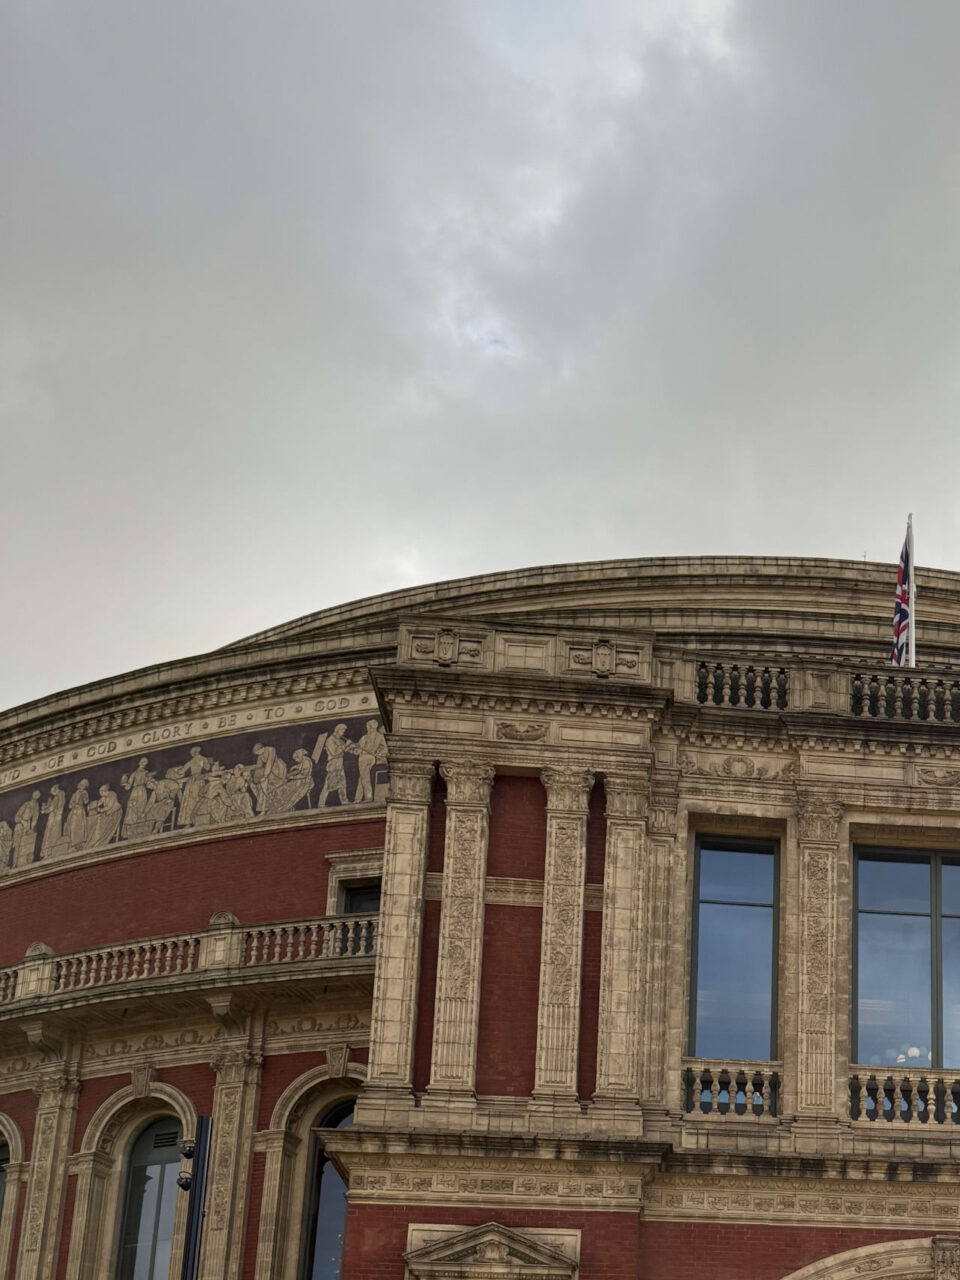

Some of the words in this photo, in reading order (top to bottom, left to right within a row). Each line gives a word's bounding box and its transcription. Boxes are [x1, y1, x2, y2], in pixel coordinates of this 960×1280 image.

[48, 755, 65, 769] OF
[87, 741, 118, 757] GOD
[142, 722, 193, 744] GLORY
[218, 714, 237, 729] BE
[264, 706, 286, 720] TO
[314, 697, 350, 712] GOD
